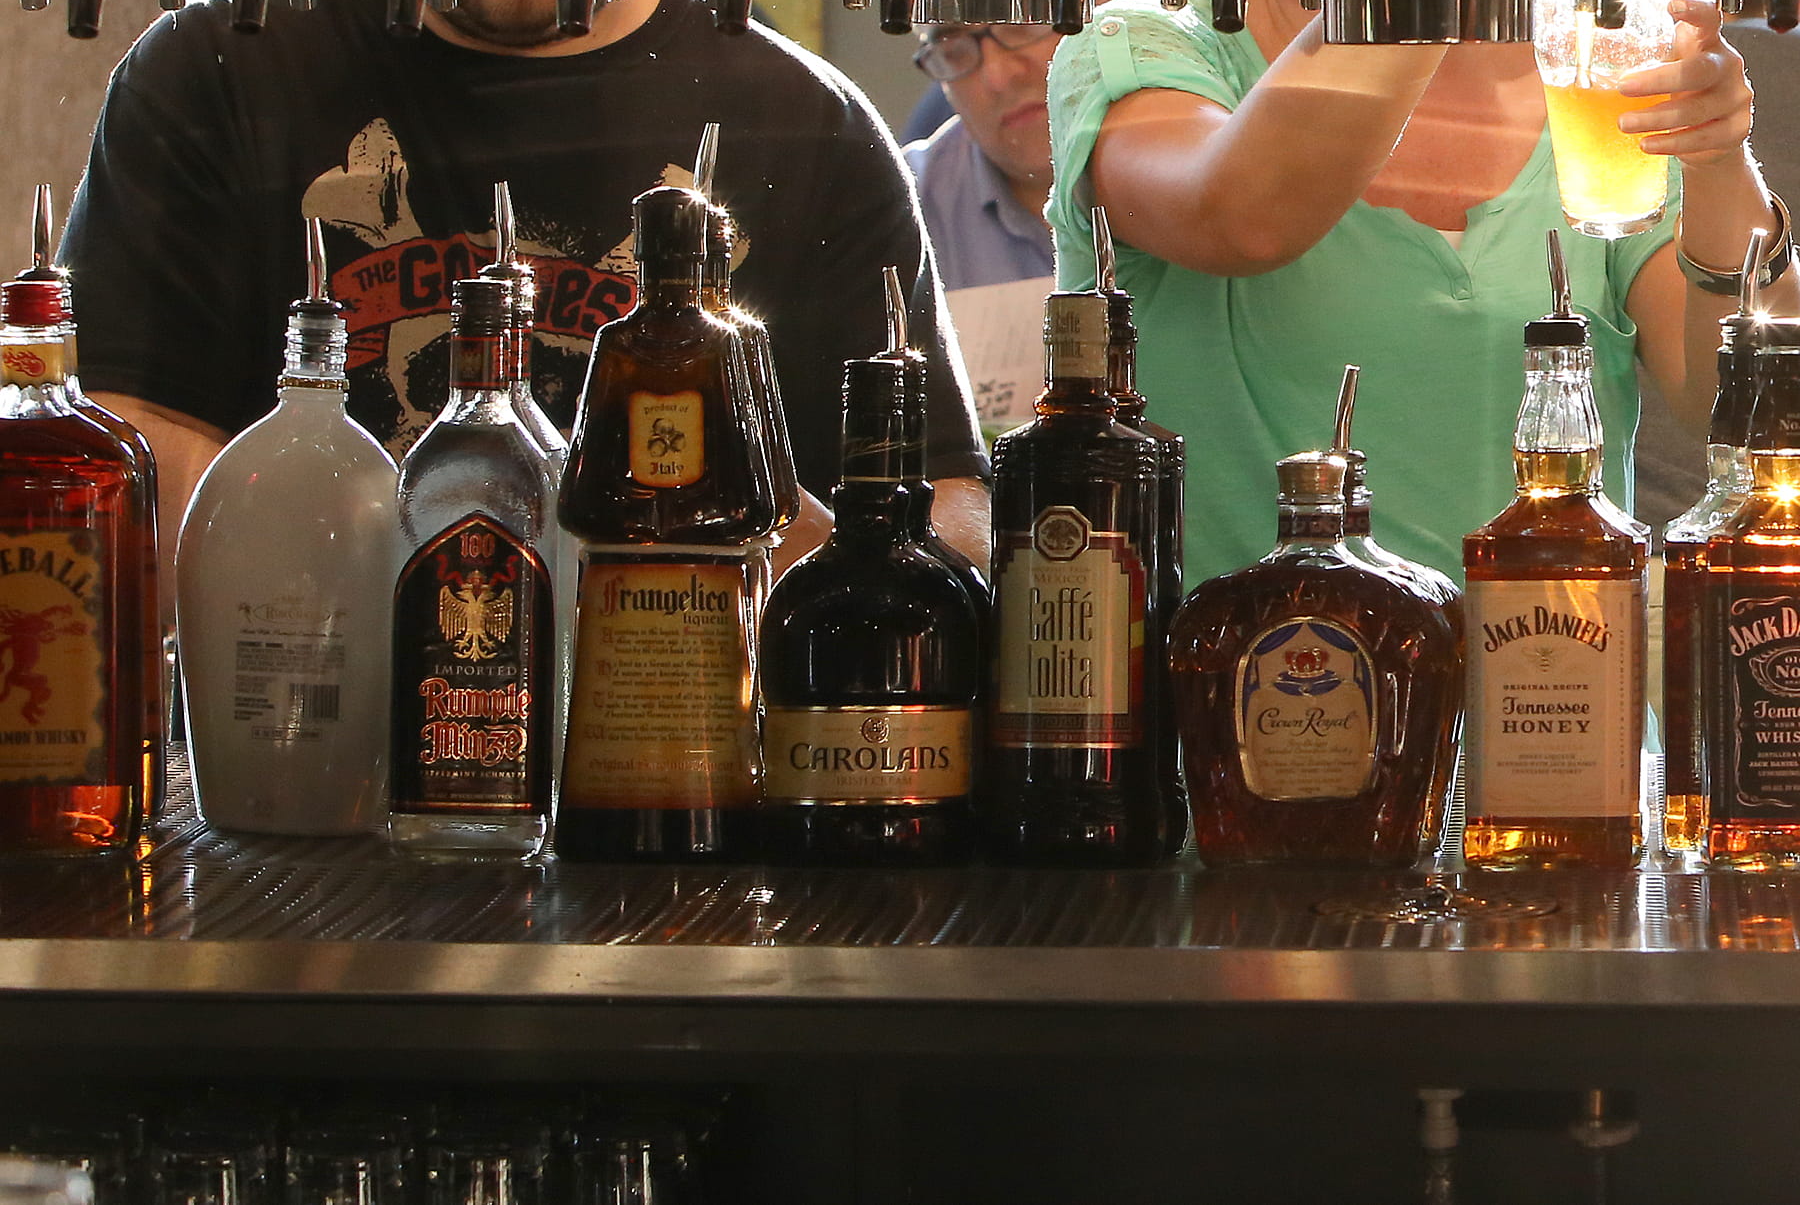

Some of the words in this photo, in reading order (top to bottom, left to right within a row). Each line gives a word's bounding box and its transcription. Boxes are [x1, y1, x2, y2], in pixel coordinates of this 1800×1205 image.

[643, 404, 678, 416] product
[679, 404, 690, 413] of
[648, 460, 685, 478] Italy
[459, 533, 496, 559] 100
[1033, 573, 1087, 584] MEXICO
[602, 574, 730, 616] Frangelico
[1028, 586, 1093, 642] Caffé
[1482, 614, 1532, 653] JACK
[1533, 605, 1613, 653] DANIEL'S
[1727, 617, 1777, 658] JACK
[434, 665, 518, 677] IMPORTED
[1028, 643, 1093, 699] Lolita
[419, 677, 532, 721] Rumple
[1502, 696, 1590, 716] Tennessee
[1257, 707, 1303, 735] Crown
[1291, 707, 1357, 737] Royal
[1502, 720, 1591, 734] HONEY
[33, 729, 87, 745] WHISKY
[419, 720, 529, 768] Minze
